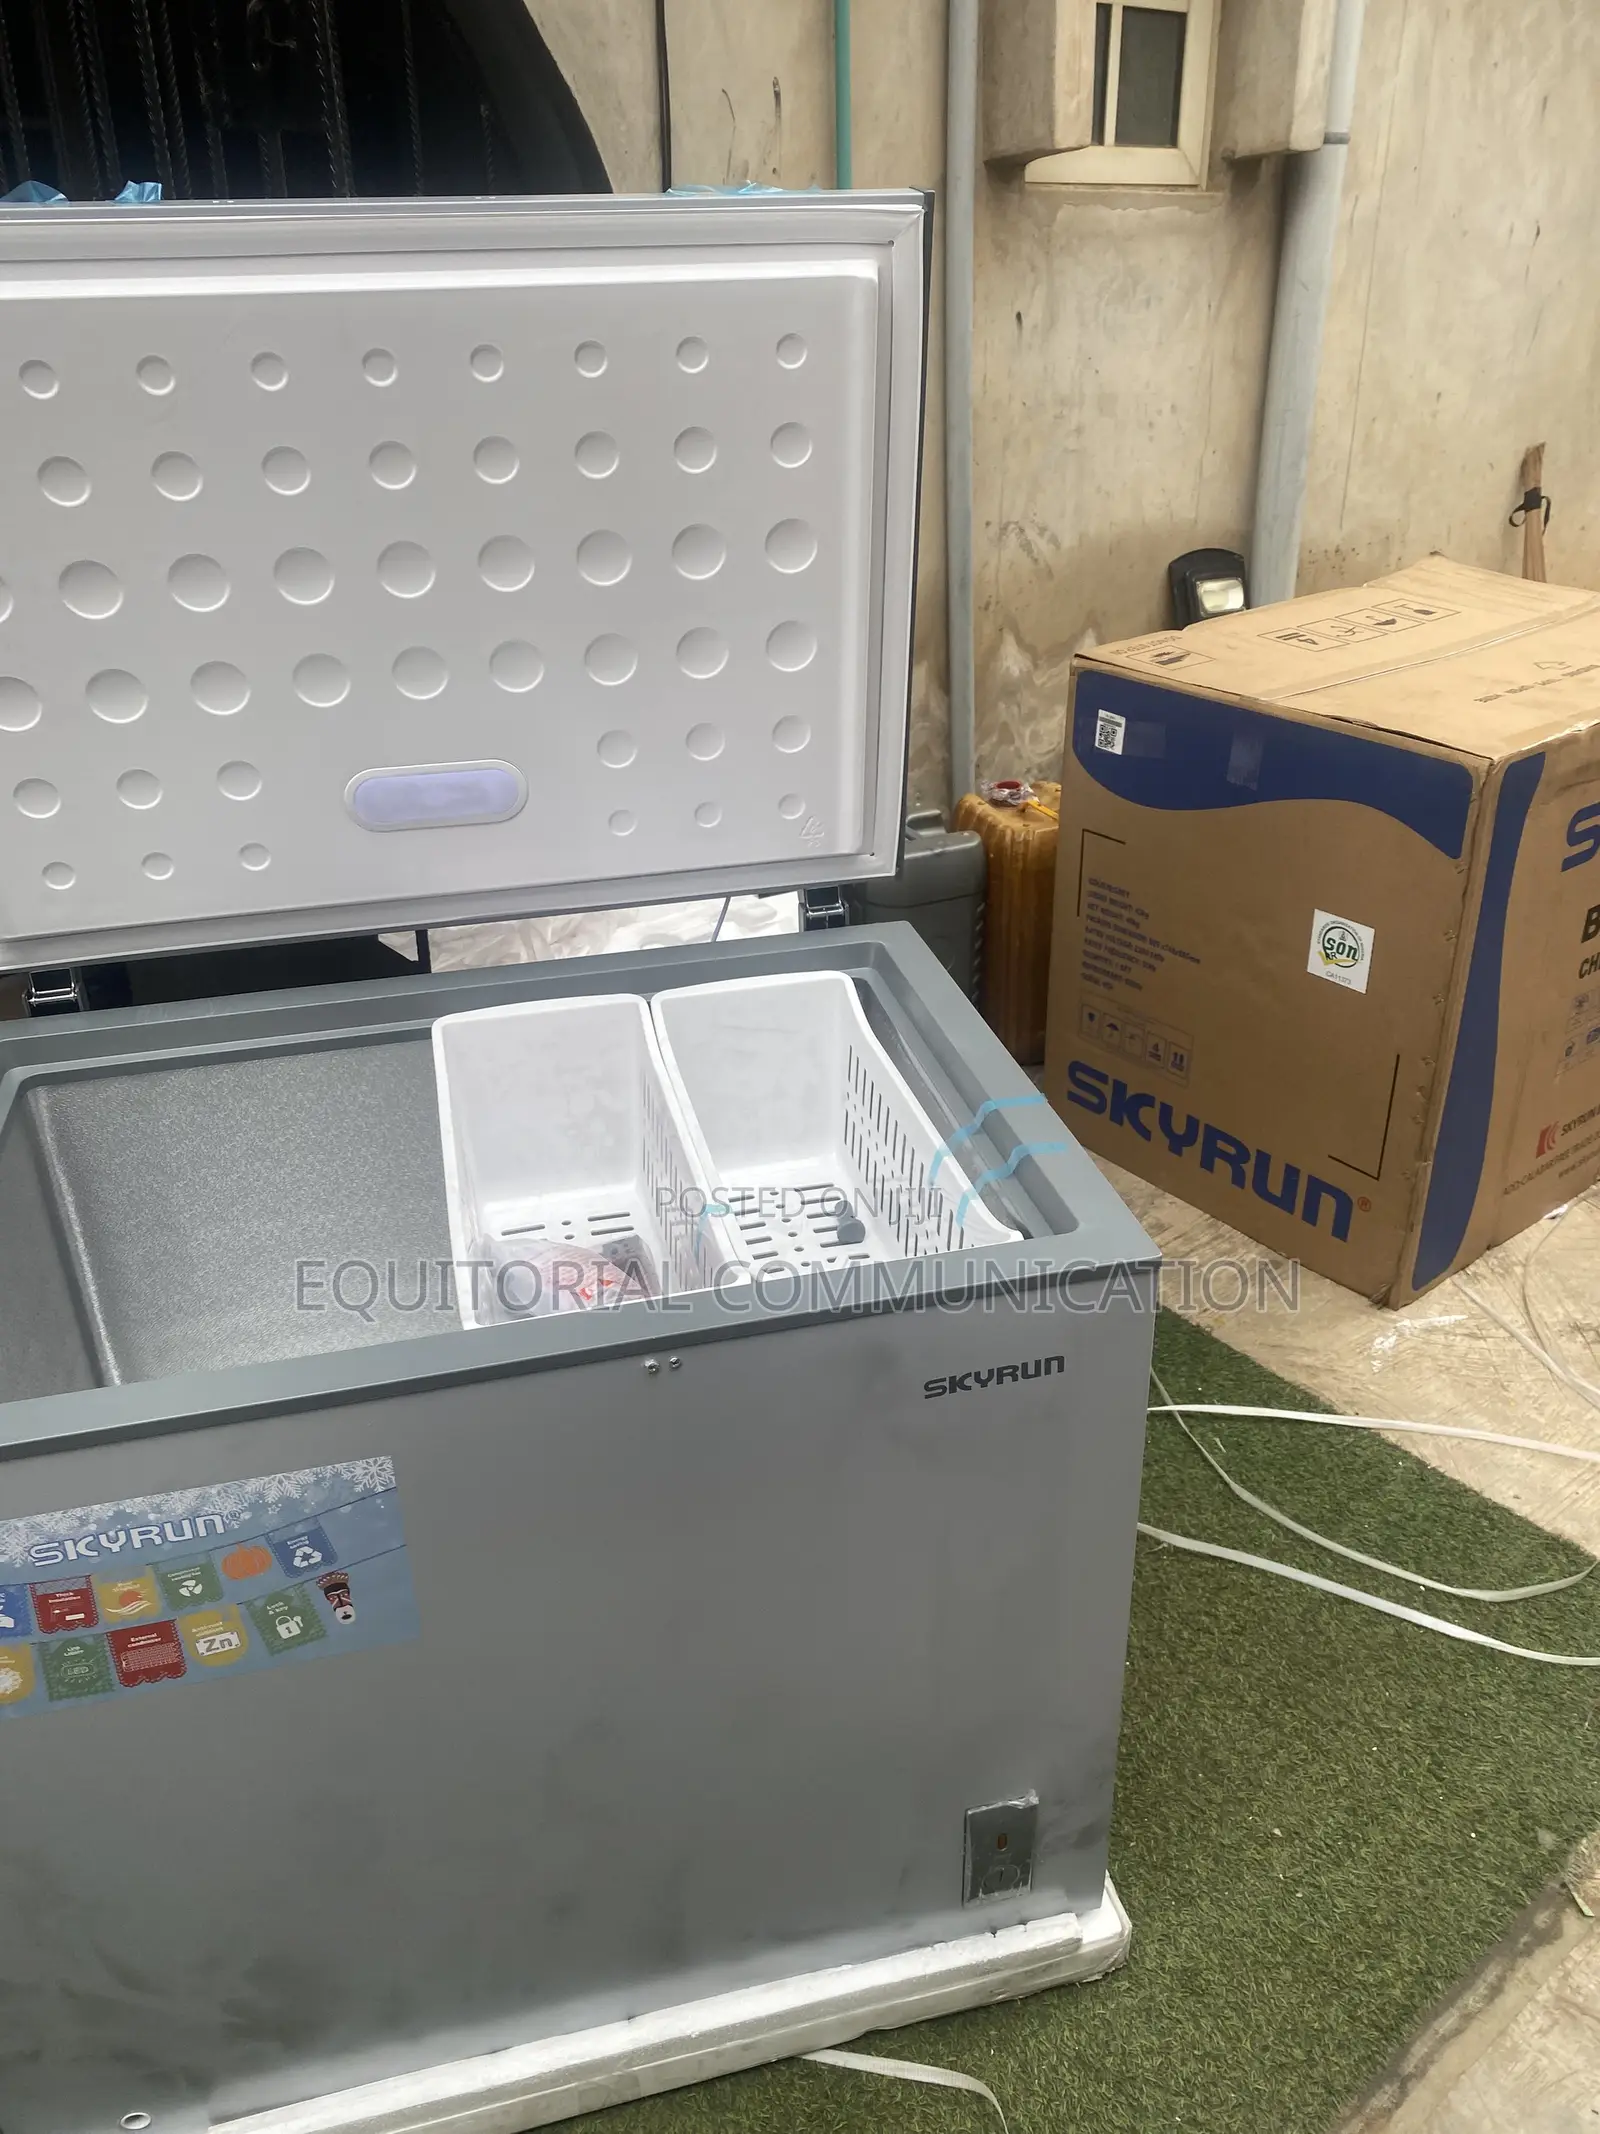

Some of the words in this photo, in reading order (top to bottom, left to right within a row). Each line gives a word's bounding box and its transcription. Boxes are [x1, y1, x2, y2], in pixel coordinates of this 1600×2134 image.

[1067, 1060, 1354, 1243] SKYRUN
[923, 1355, 1065, 1400] SKYRUN
[29, 1513, 227, 1567] SKYRUN
[203, 1638, 233, 1652] Zn
